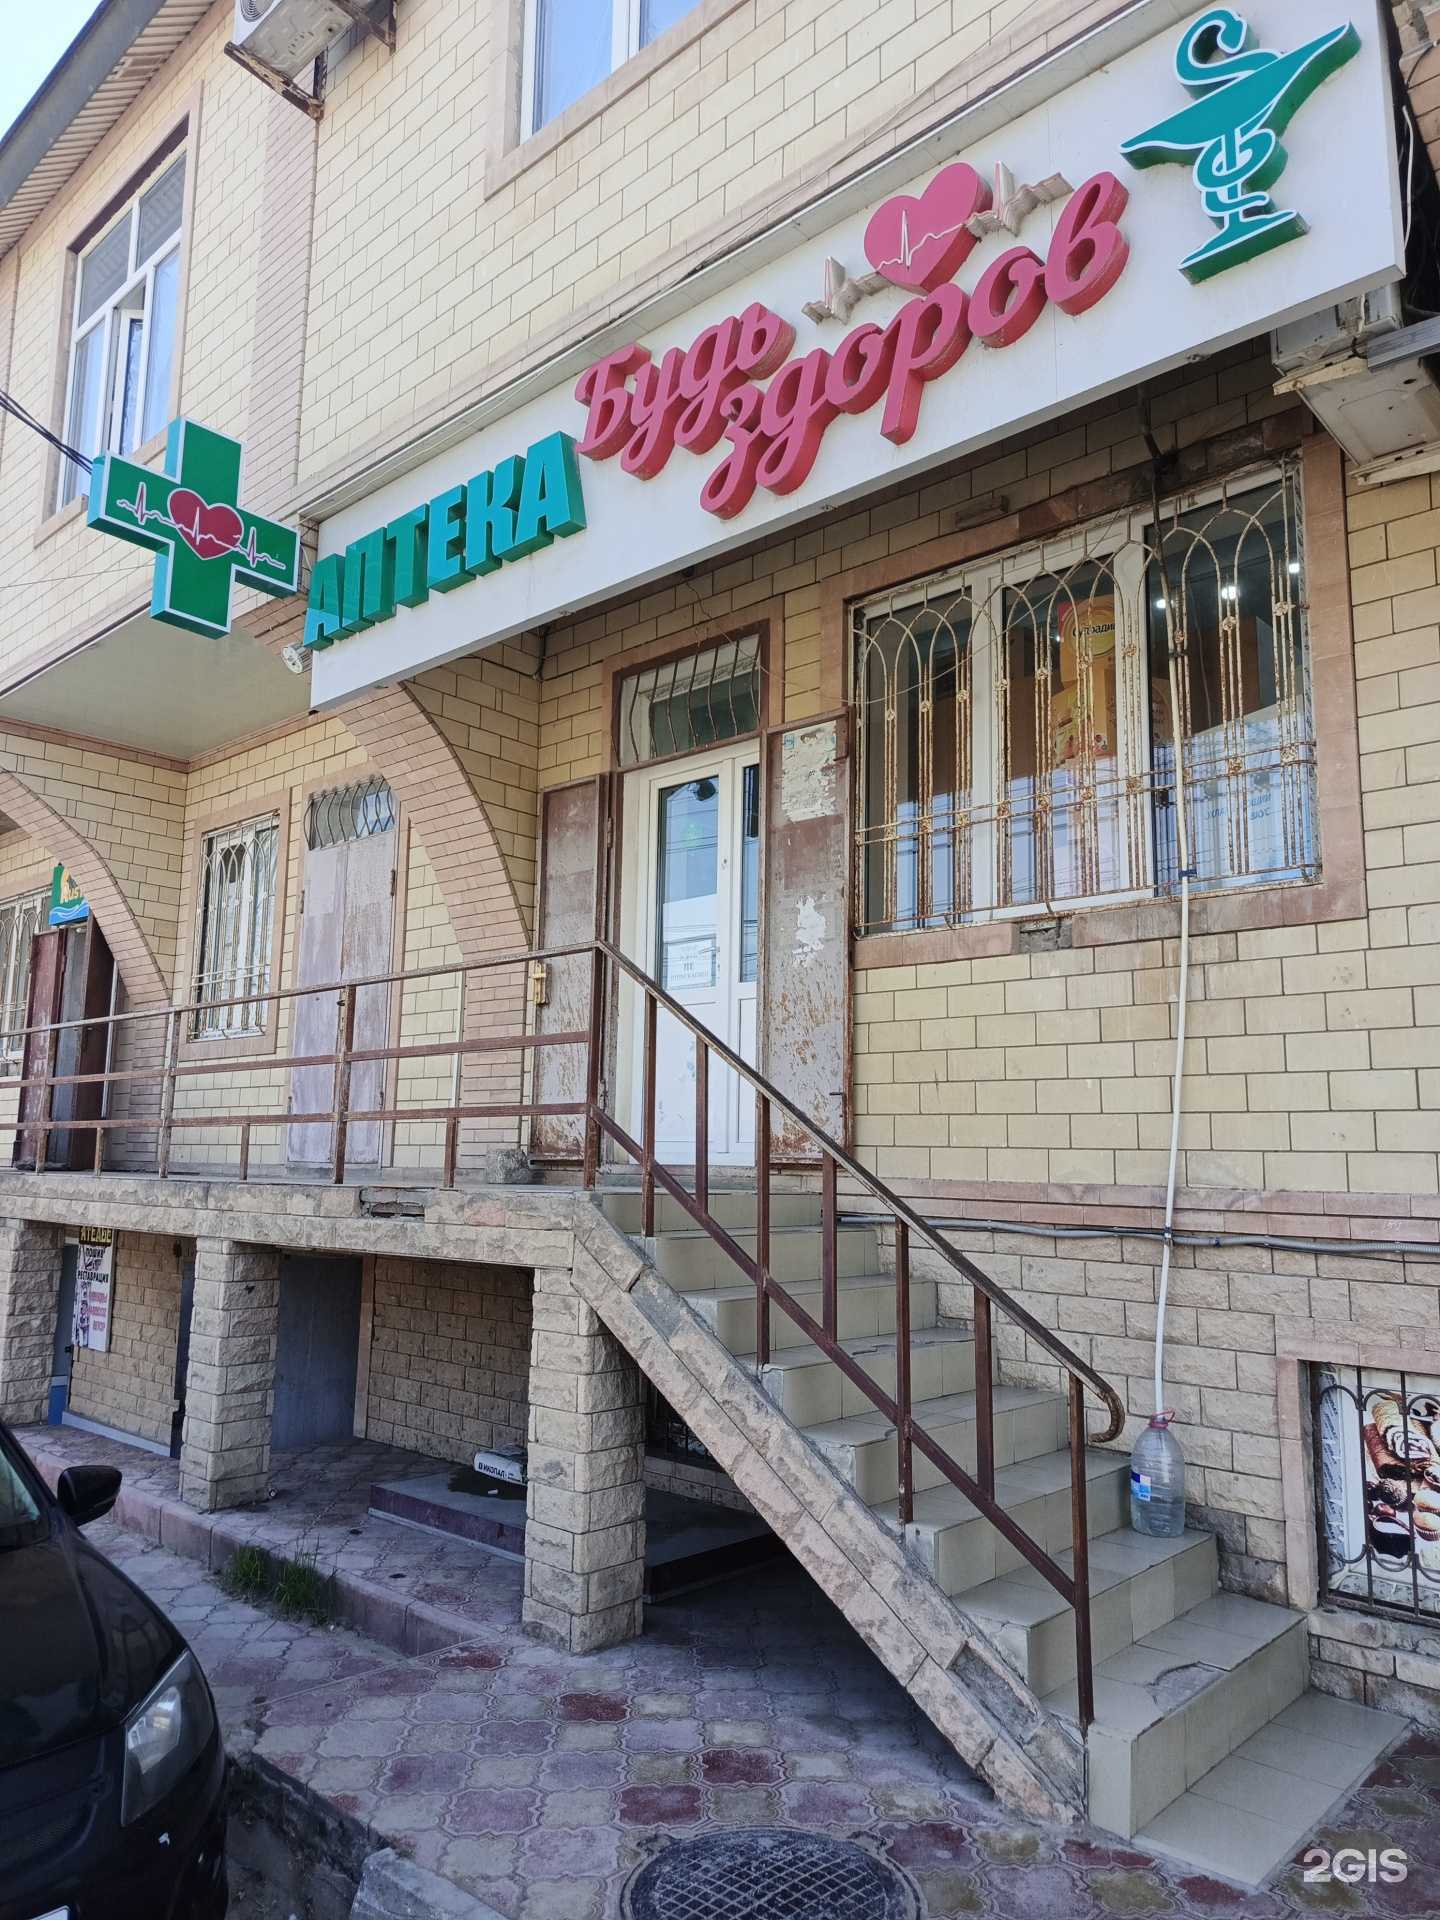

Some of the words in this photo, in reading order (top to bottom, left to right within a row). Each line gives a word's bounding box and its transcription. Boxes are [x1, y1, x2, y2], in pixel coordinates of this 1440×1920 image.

[575, 302, 796, 481] Будь
[700, 171, 1130, 520] здоров
[303, 430, 587, 651] АПТЕКА
[80, 1226, 112, 1243] АТЕЛЬЕ
